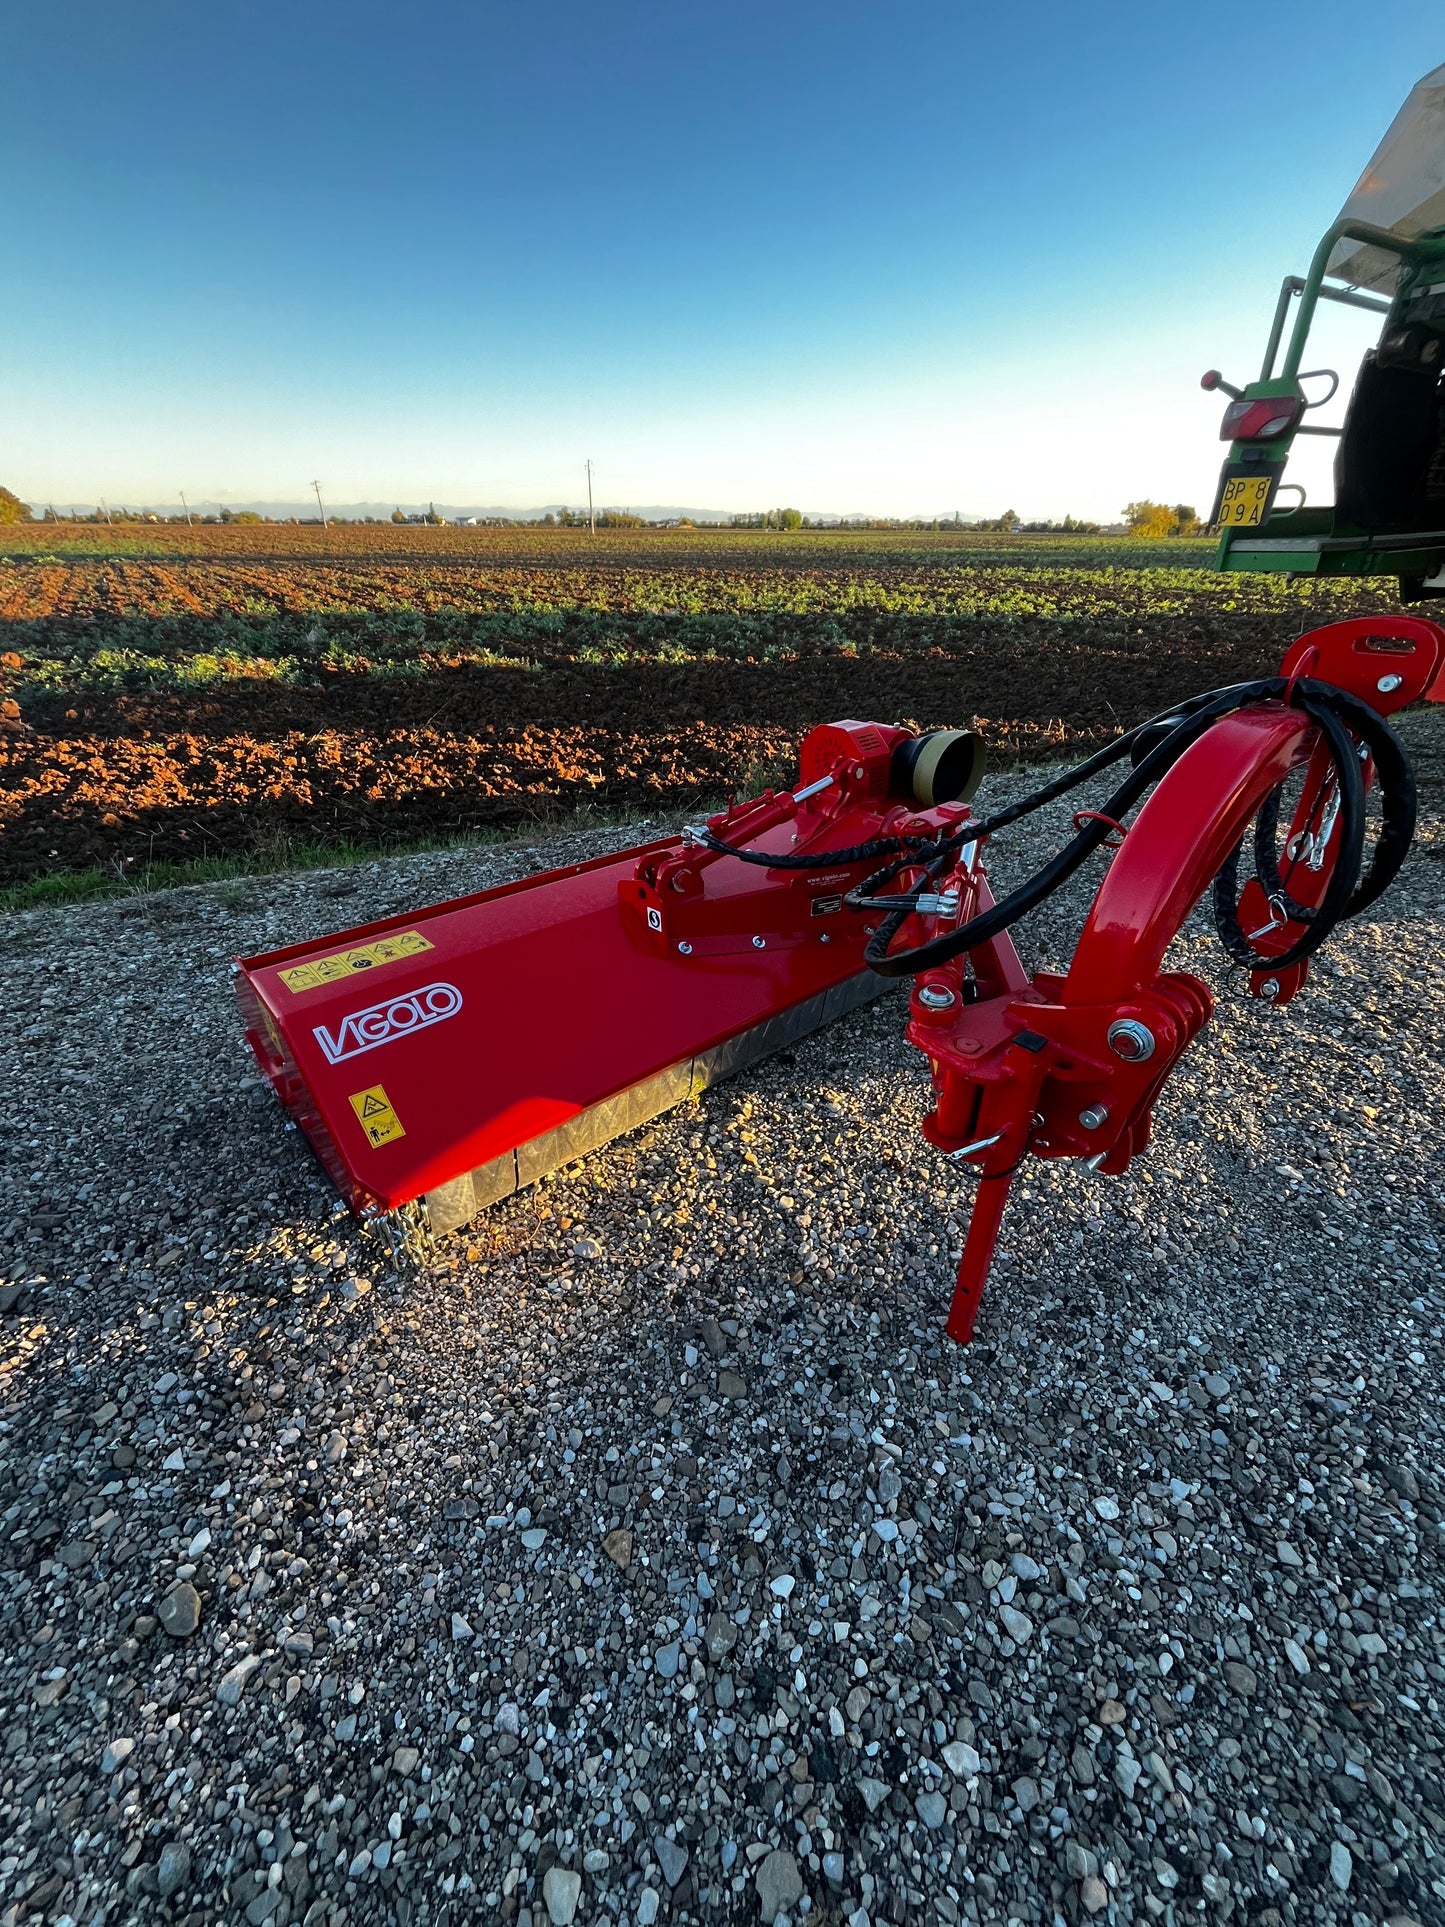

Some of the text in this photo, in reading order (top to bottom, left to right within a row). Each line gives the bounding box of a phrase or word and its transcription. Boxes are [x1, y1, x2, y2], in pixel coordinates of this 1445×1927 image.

[1224, 481, 1267, 501] BP 8
[312, 982, 463, 1065] VIGOLO
